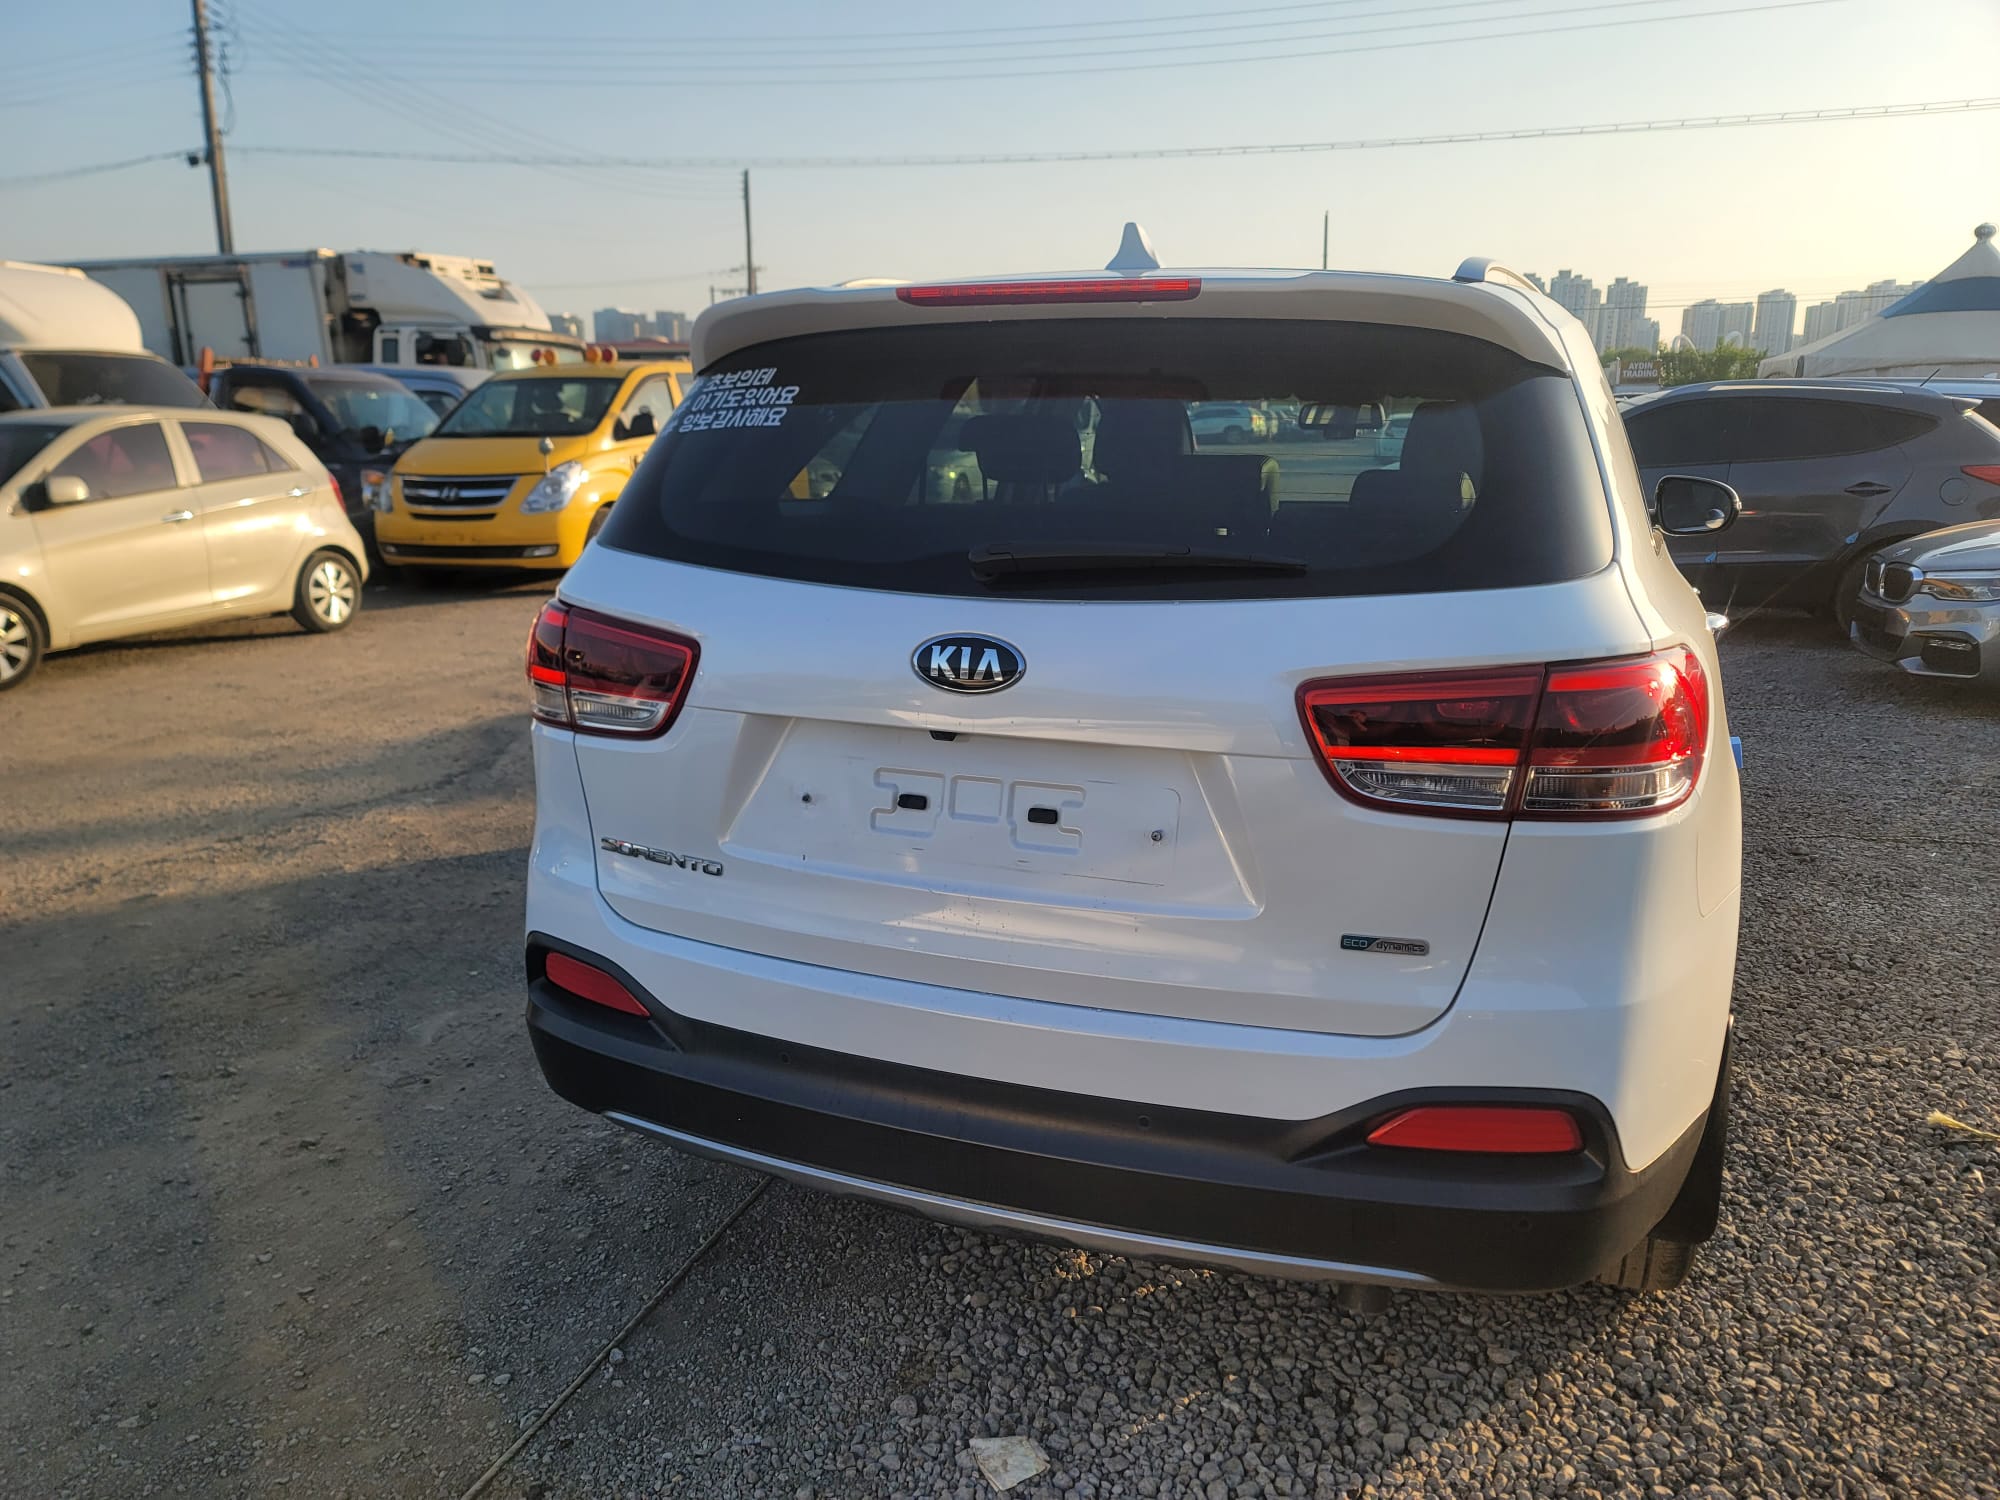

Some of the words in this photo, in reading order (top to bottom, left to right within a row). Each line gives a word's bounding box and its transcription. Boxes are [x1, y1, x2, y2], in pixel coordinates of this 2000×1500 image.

[1623, 369, 1658, 377] TRADING
[1628, 361, 1654, 370] AYDIN
[702, 367, 778, 392] 초보인데
[930, 645, 1004, 681] KIA
[601, 837, 724, 876] SORENTO
[1343, 939, 1368, 948] ECO
